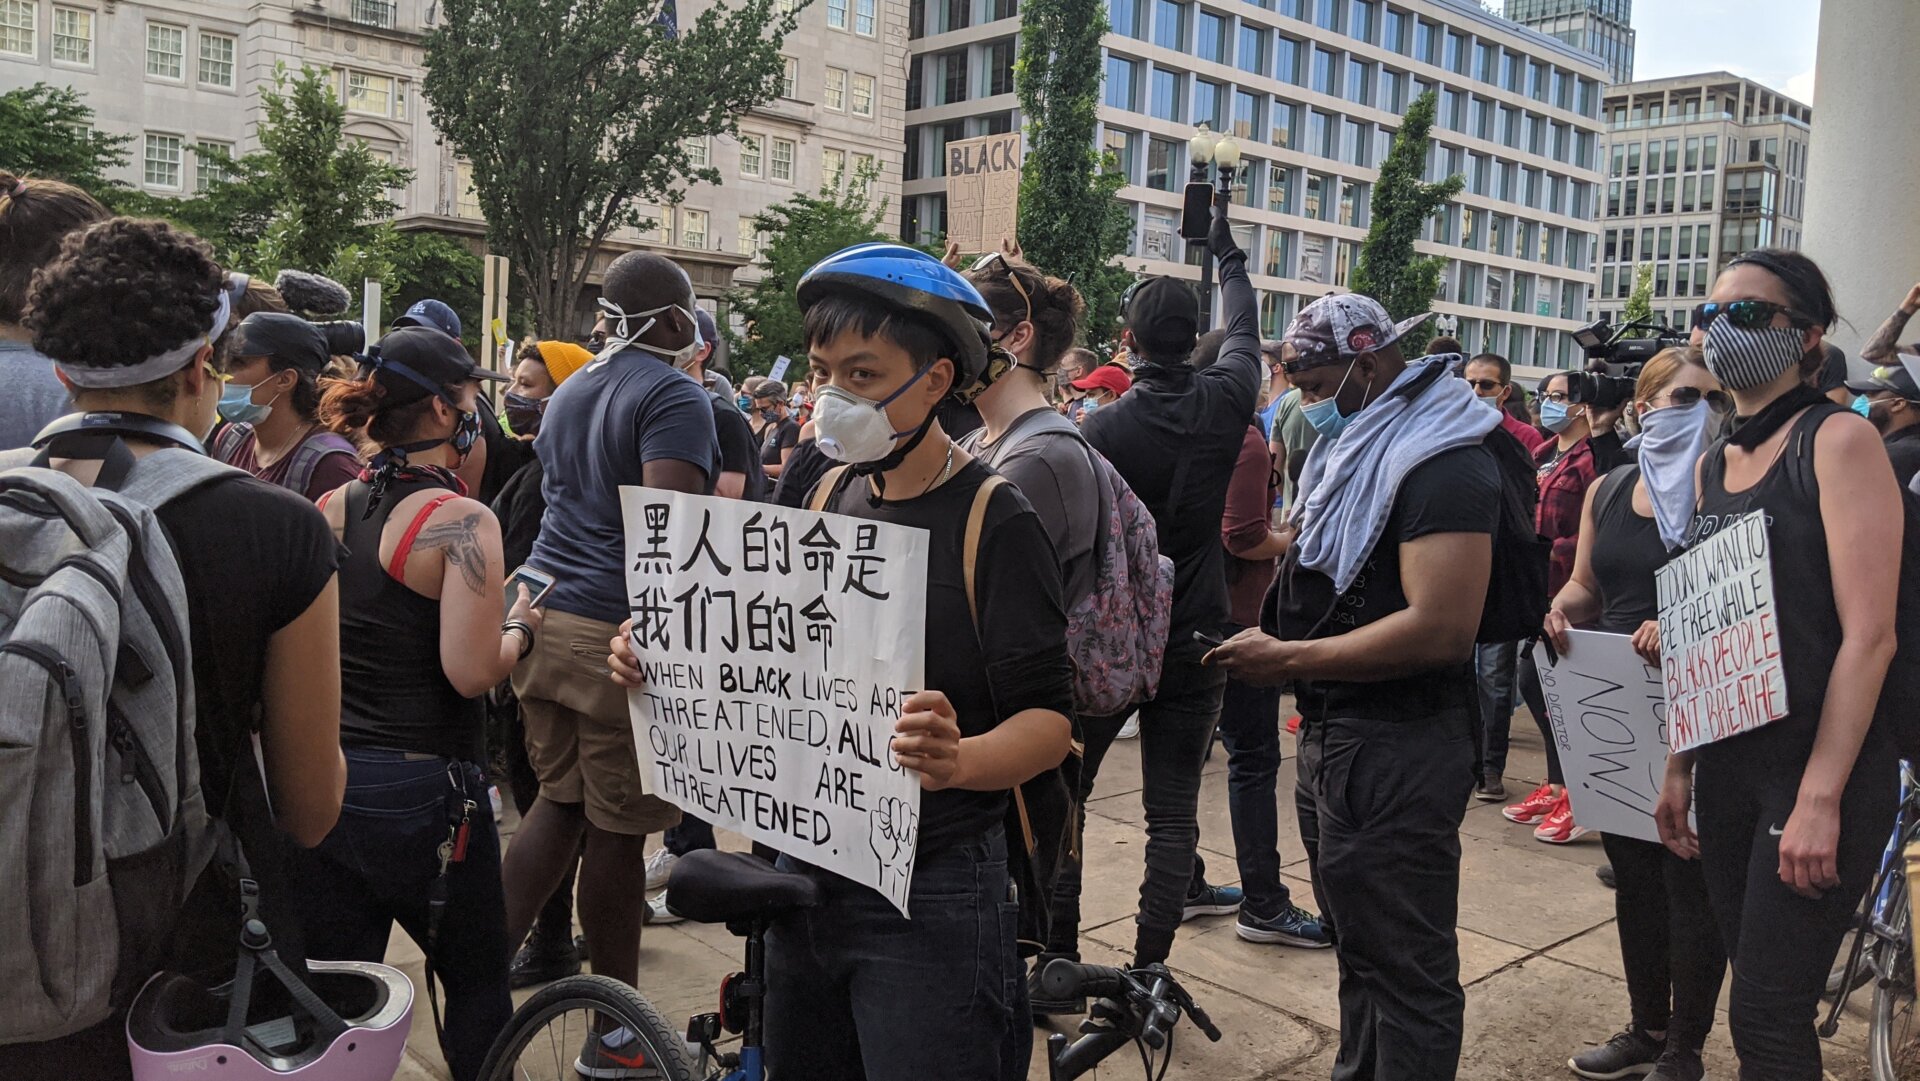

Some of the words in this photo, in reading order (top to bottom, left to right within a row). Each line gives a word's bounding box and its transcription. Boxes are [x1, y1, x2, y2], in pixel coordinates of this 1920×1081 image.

[949, 170, 1016, 208] LIVES
[950, 139, 1017, 176] BLACK
[949, 207, 1016, 242] MATTER
[634, 503, 889, 600] 黑人的命是
[1655, 569, 1668, 614] I
[1701, 523, 1741, 587] WANT
[1743, 516, 1765, 564] TO
[630, 582, 837, 671] 我们的命
[1660, 610, 1678, 656] BE
[1681, 591, 1716, 645] FREE
[1712, 569, 1767, 629] WHILE
[637, 661, 703, 690] WHEN
[720, 663, 792, 700] BLACK
[803, 671, 858, 712] LIVES
[1540, 667, 1556, 688] NO
[1666, 640, 1713, 701] BLACK
[1712, 613, 1780, 684] PEOPLE
[838, 719, 882, 767] ALL
[1547, 692, 1571, 751] DICTATOR
[1704, 666, 1783, 740] BREATHE
[649, 725, 689, 769] OUR
[698, 738, 776, 782] LIVES
[815, 762, 867, 812] ARE
[1569, 670, 1656, 818] NOW!
[656, 760, 838, 855] THREATENED.
